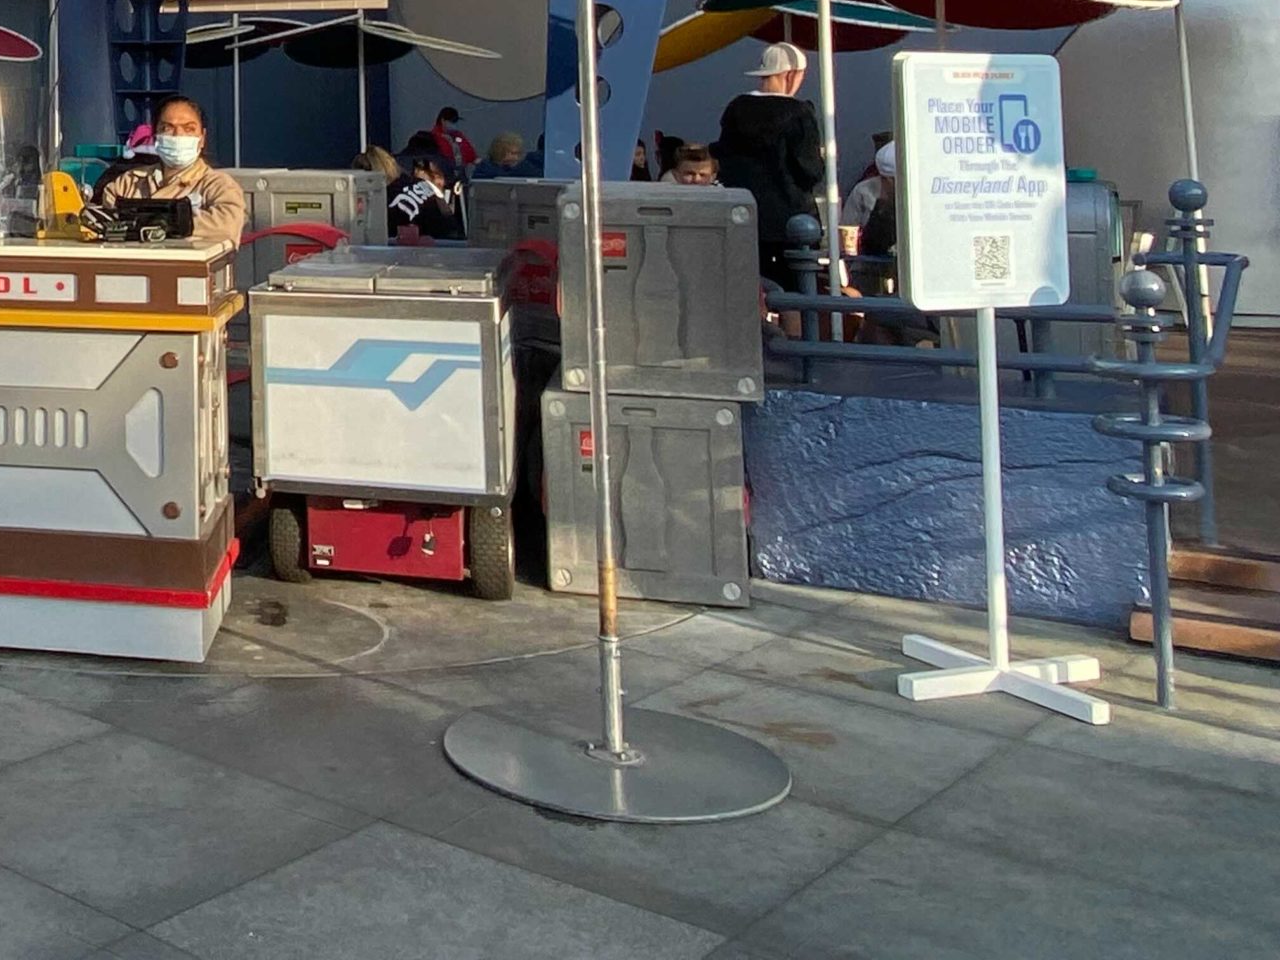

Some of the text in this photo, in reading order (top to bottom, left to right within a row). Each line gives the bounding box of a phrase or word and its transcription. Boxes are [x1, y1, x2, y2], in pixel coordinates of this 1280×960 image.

[928, 98, 994, 114] Place Your
[934, 116, 995, 134] MOBILE
[942, 136, 995, 154] ORDER
[931, 176, 1047, 198] Disneyland App
